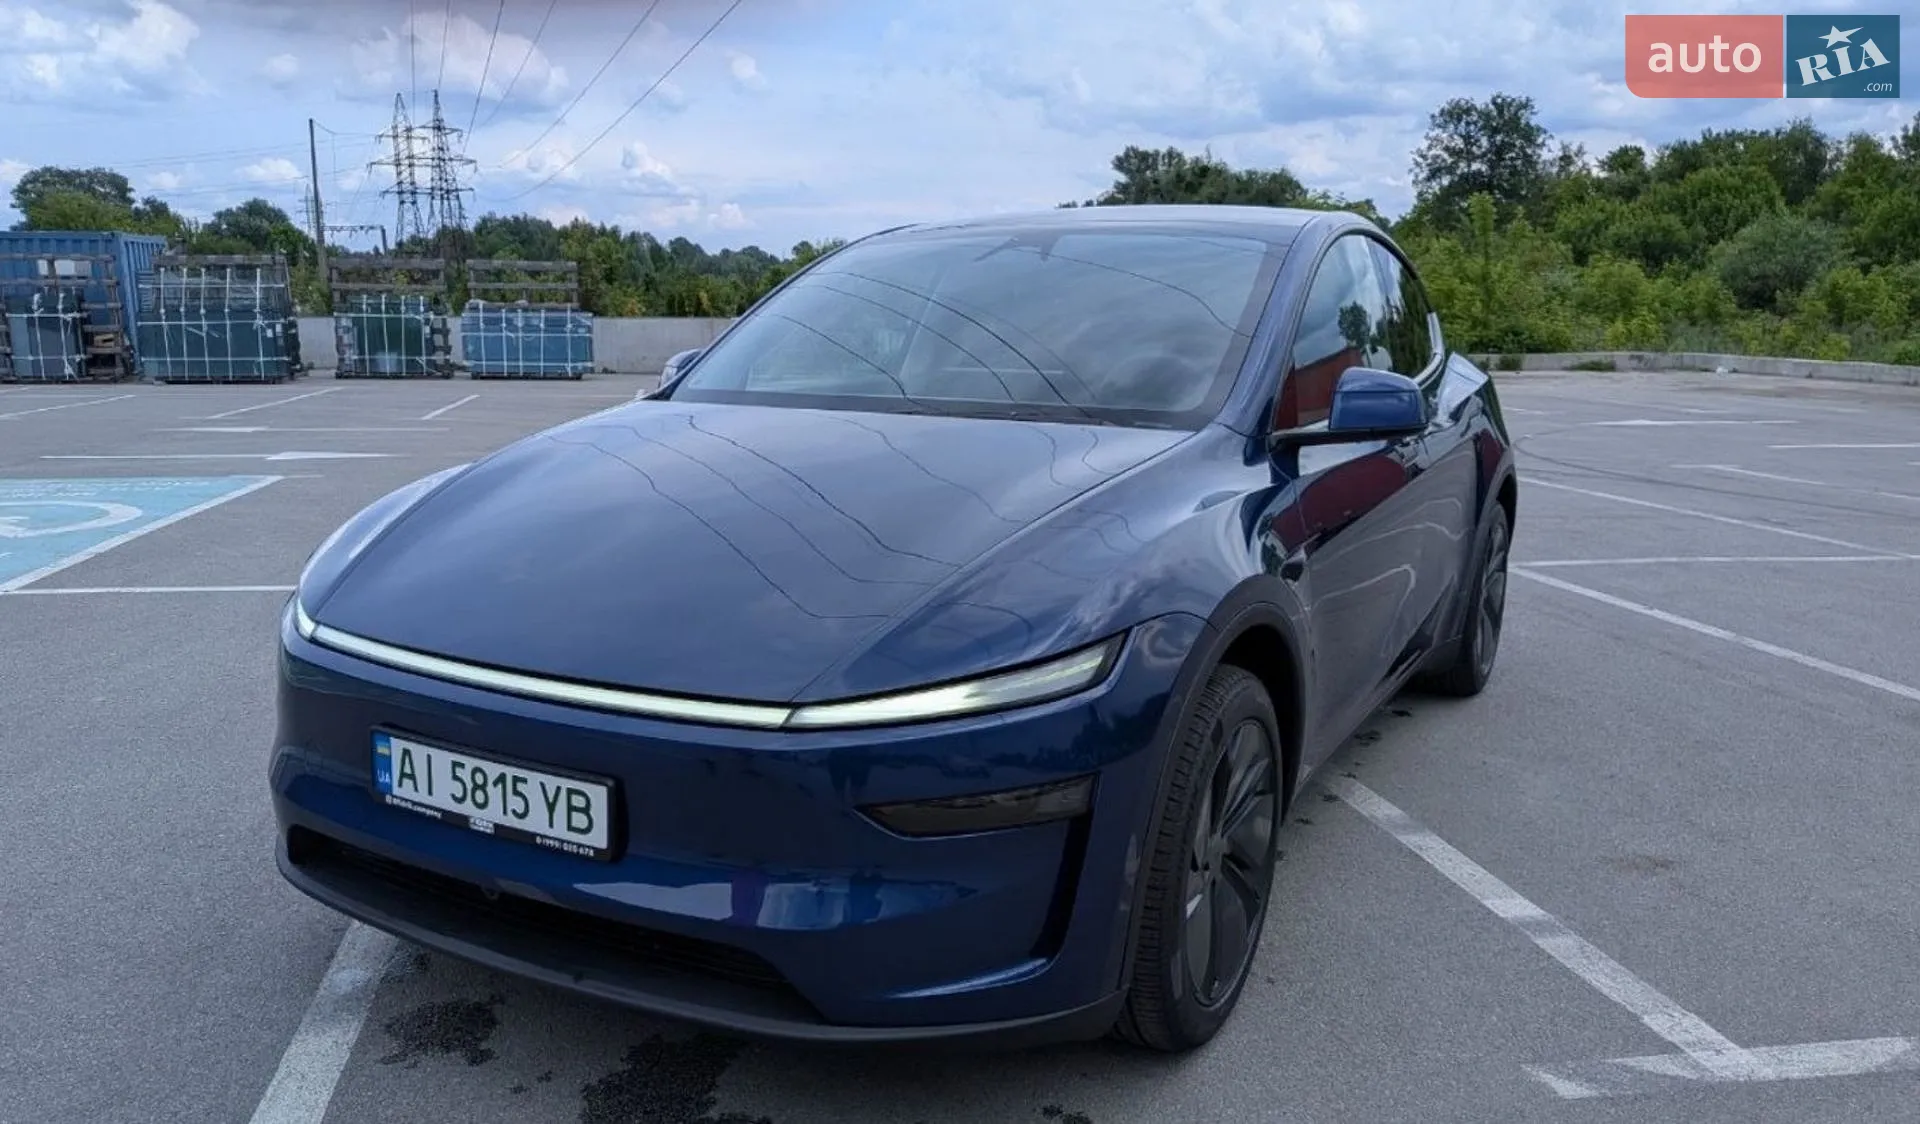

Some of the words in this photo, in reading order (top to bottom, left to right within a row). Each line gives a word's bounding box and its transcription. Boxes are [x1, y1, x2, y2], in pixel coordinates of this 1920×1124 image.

[376, 767, 391, 785] UA
[397, 747, 433, 797] AI
[450, 760, 531, 820] 5815
[539, 781, 594, 835] YB
